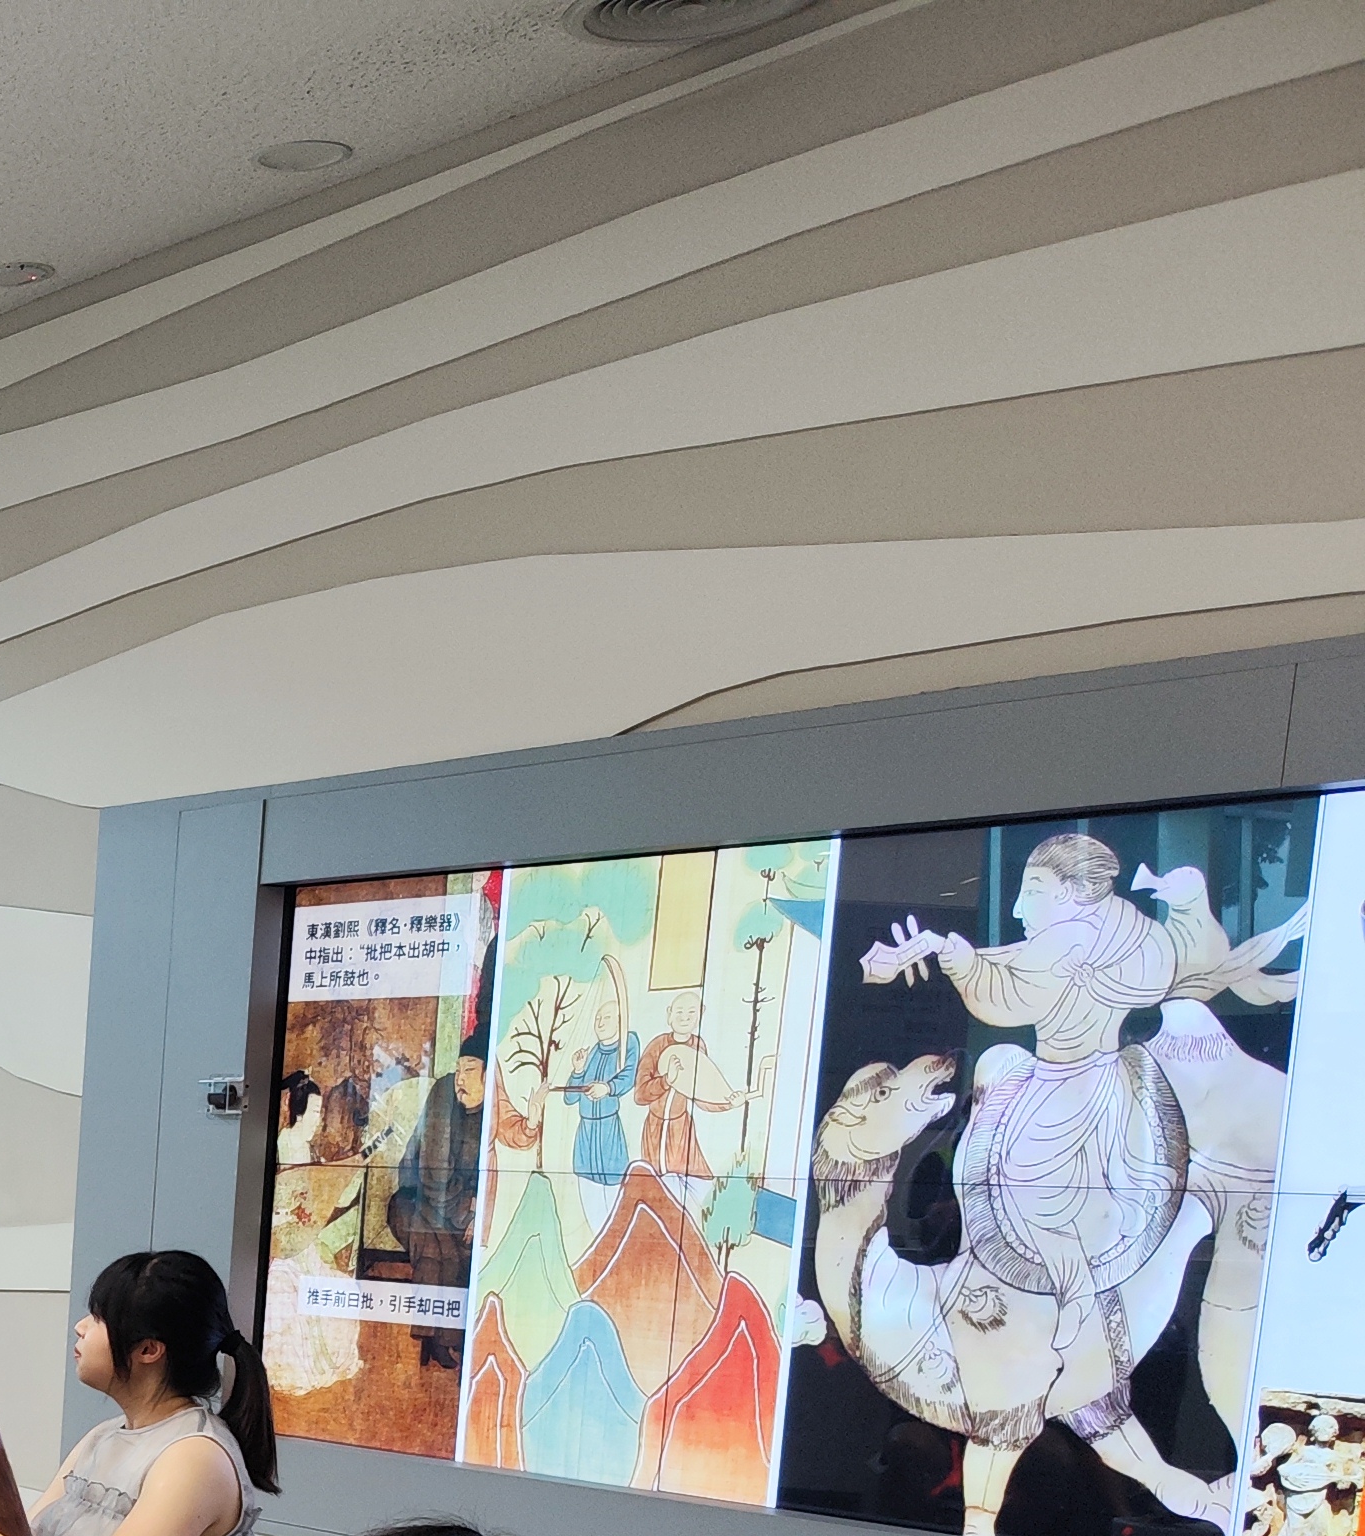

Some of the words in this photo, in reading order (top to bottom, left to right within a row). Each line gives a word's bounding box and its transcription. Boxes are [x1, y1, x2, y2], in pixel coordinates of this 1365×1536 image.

[302, 969, 380, 989] 馬上所鼓也。
